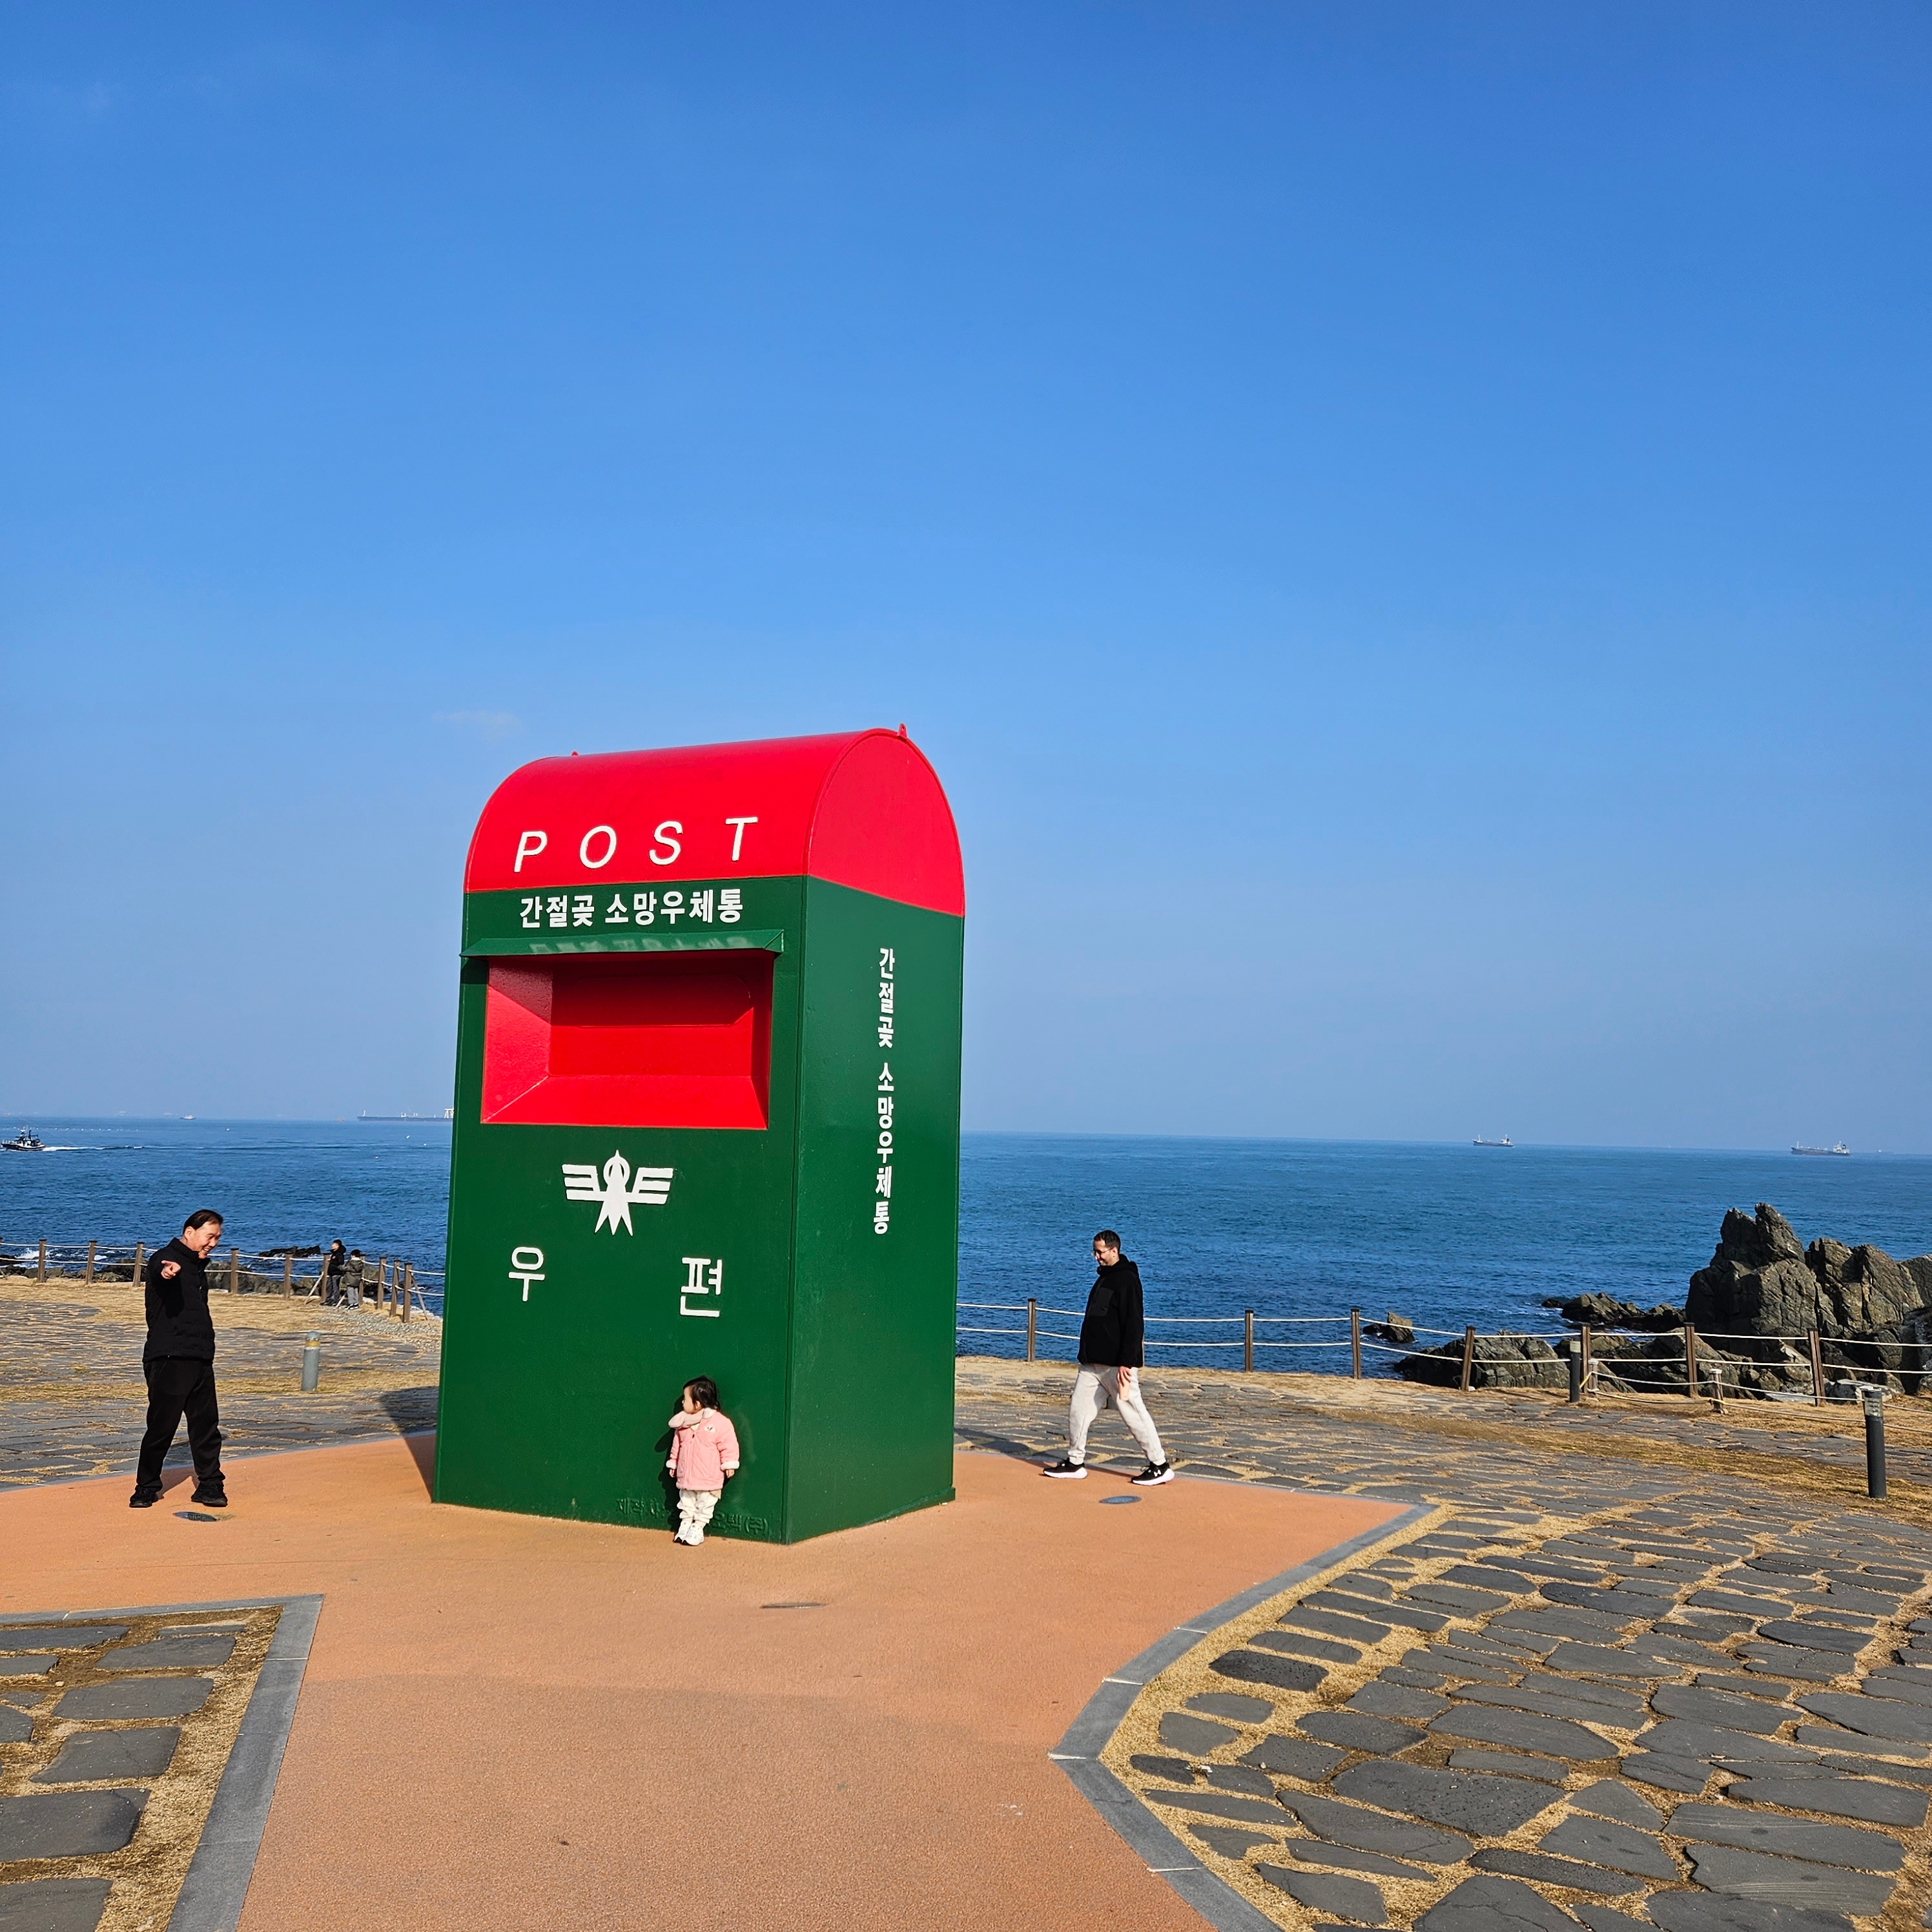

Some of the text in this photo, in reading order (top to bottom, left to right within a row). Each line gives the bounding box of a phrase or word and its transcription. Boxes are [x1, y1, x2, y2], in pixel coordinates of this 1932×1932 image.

[514, 816, 758, 873] POST
[520, 889, 744, 929] 간절곶 소망우체통
[873, 947, 896, 1235] 간절곶 소망우체통
